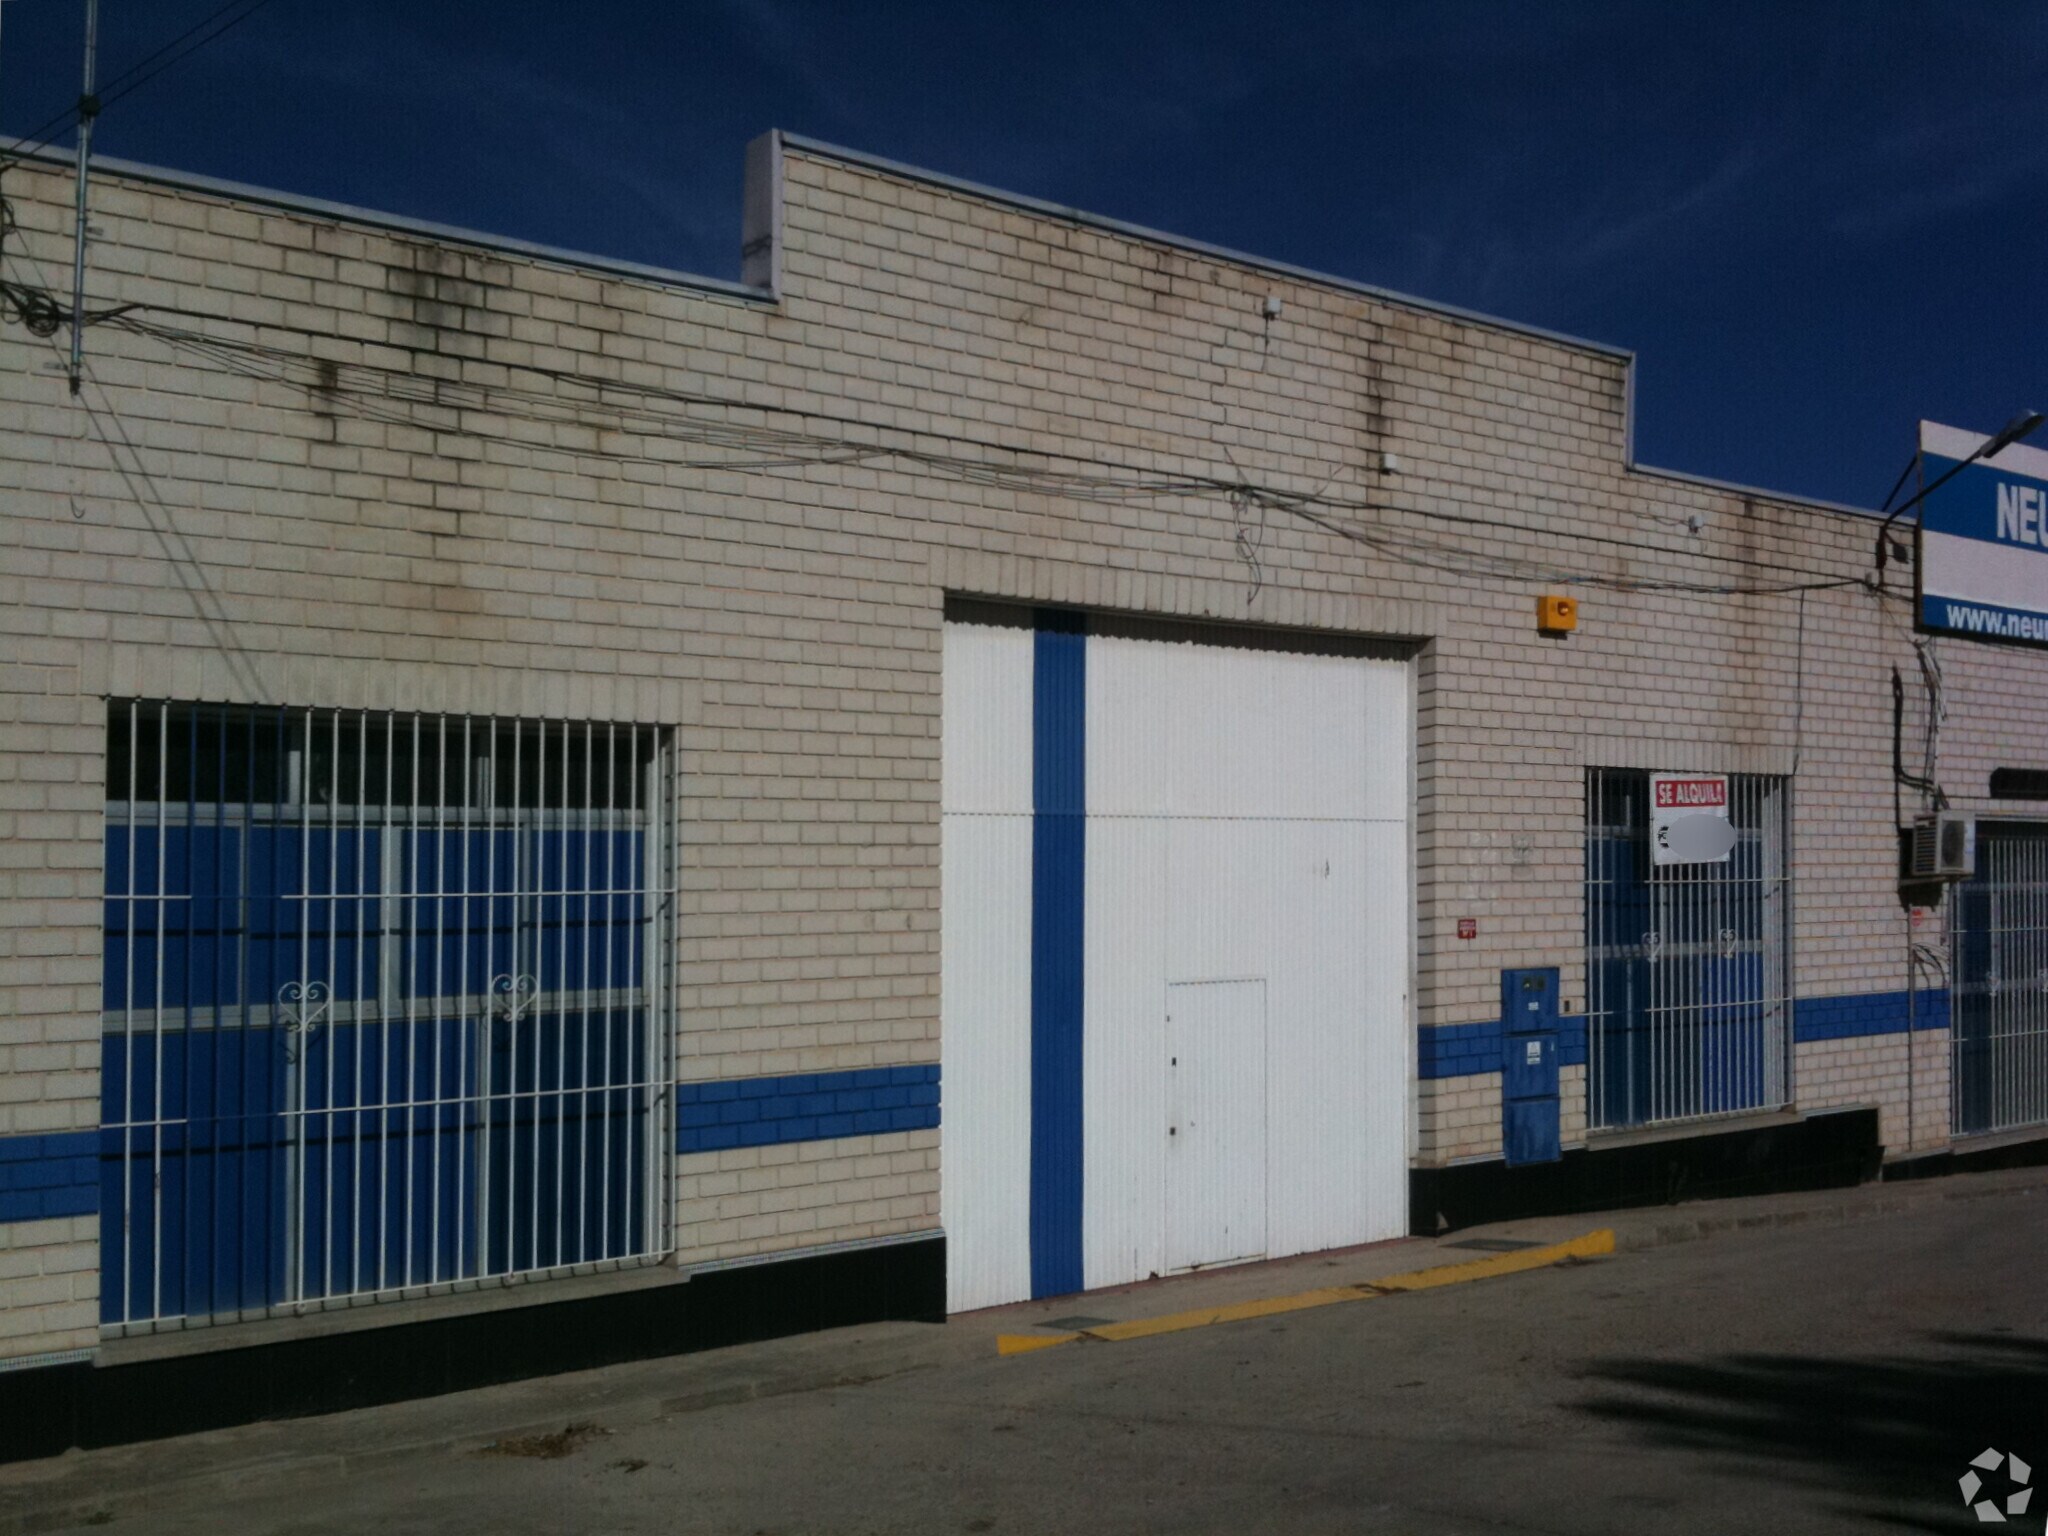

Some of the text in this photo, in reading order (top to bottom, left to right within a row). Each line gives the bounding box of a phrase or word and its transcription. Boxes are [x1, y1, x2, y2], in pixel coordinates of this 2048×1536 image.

[1946, 604, 2048, 641] www.neu
[1658, 783, 1723, 805] SE ALQUILA
